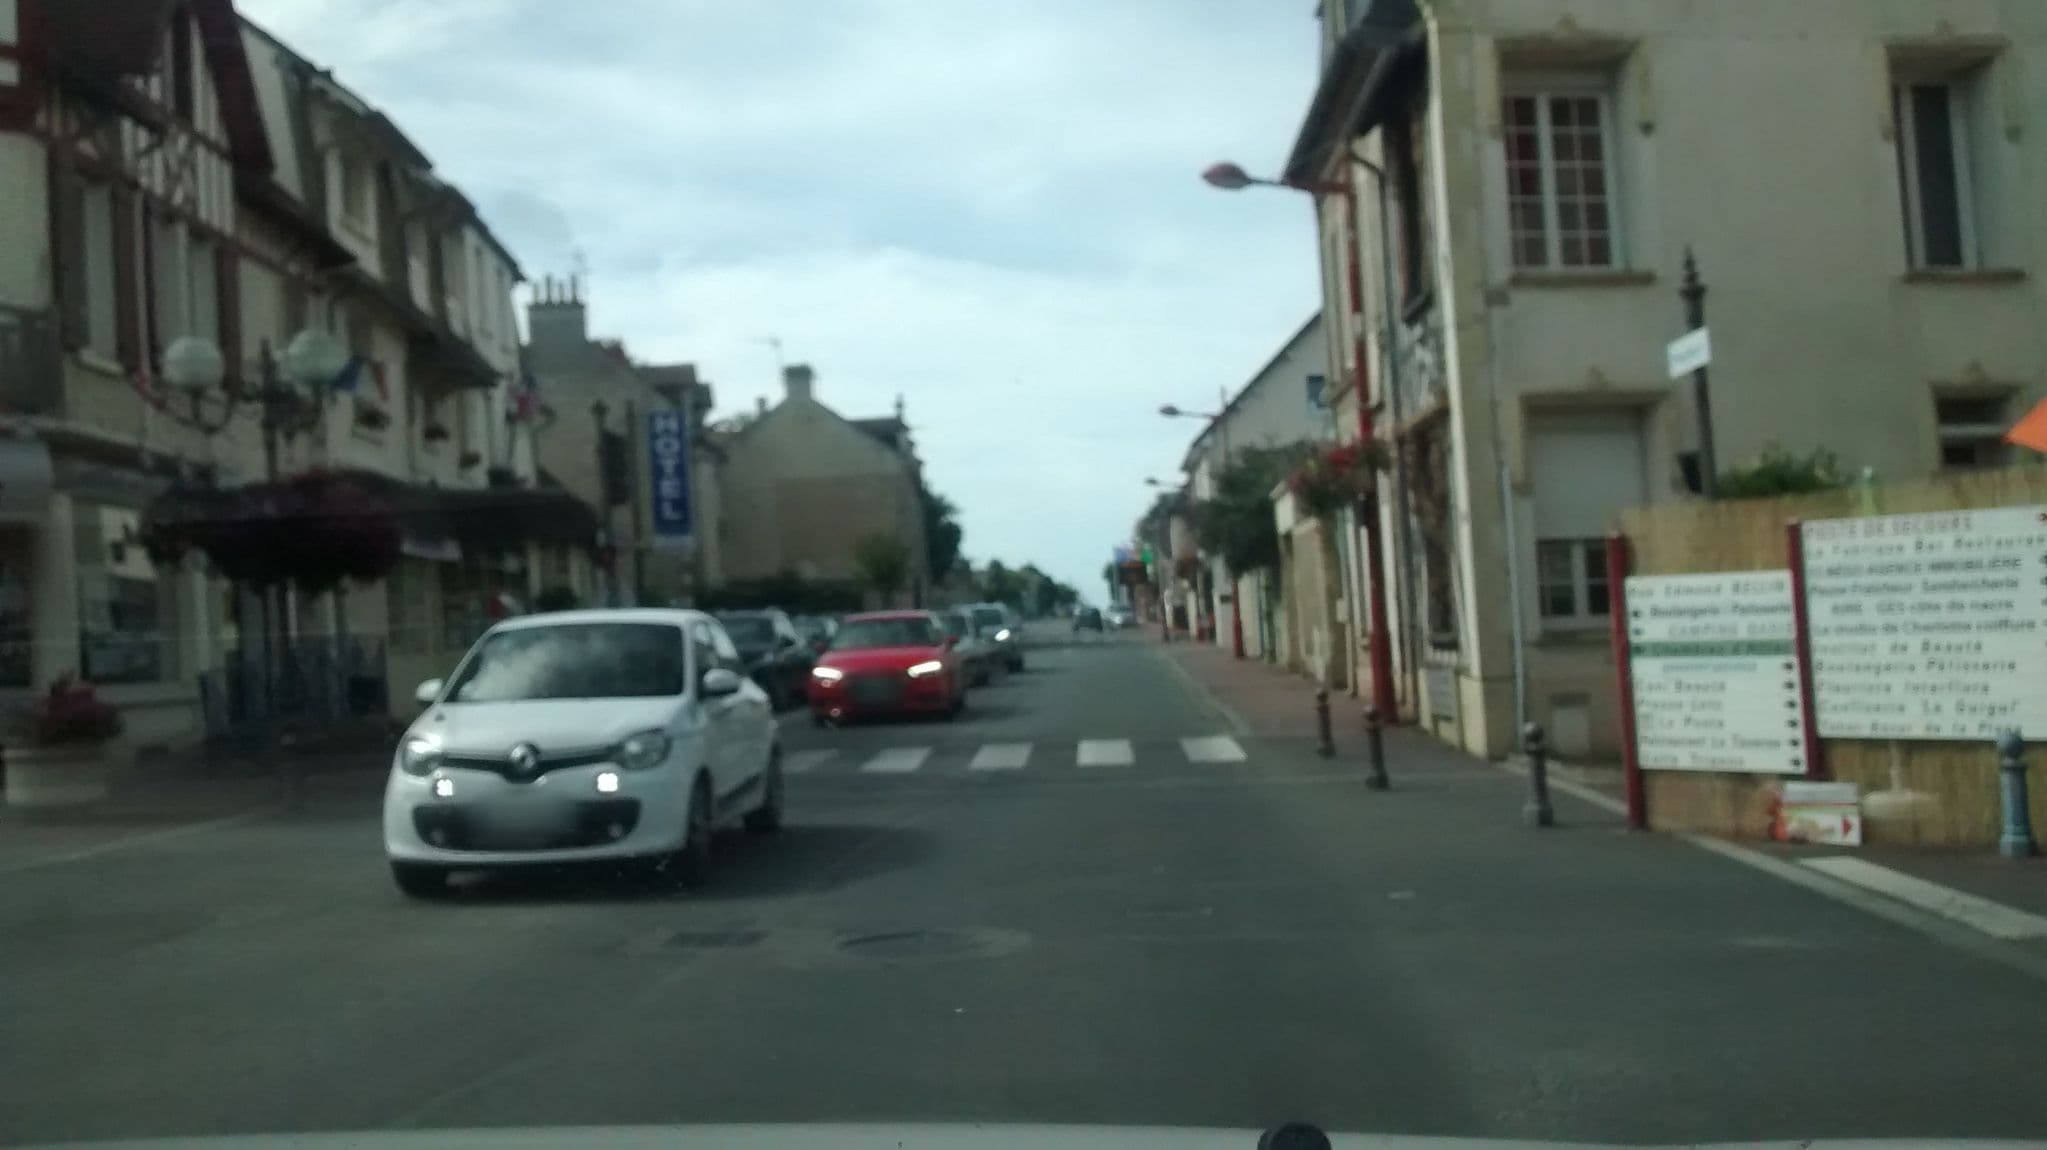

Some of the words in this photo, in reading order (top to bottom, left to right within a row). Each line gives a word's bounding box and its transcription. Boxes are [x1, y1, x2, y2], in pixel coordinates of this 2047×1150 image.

[654, 415, 683, 520] HOTEL
[1864, 521, 1885, 537] DE
[1953, 533, 2047, 550] Restauran
[1889, 640, 1909, 654] de
